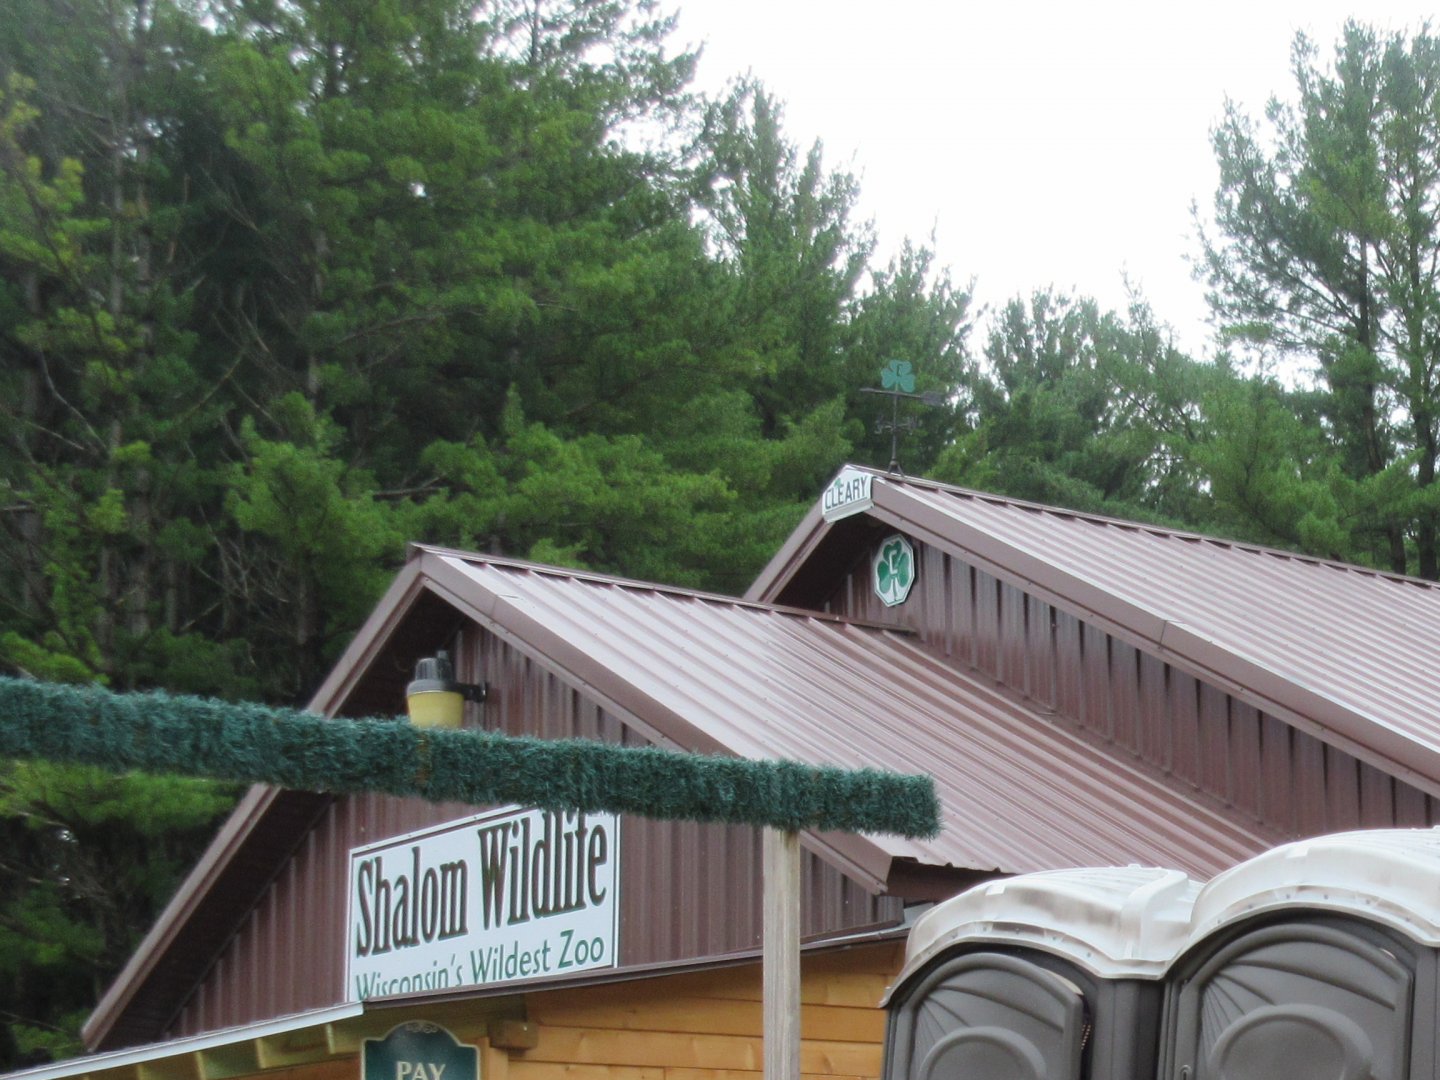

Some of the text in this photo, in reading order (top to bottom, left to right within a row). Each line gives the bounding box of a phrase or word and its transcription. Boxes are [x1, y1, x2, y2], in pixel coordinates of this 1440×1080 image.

[825, 475, 868, 509] CLEARY
[356, 806, 607, 957] Shalom Wildlife
[356, 929, 605, 1000] Wisconsin's Wildest Zoo
